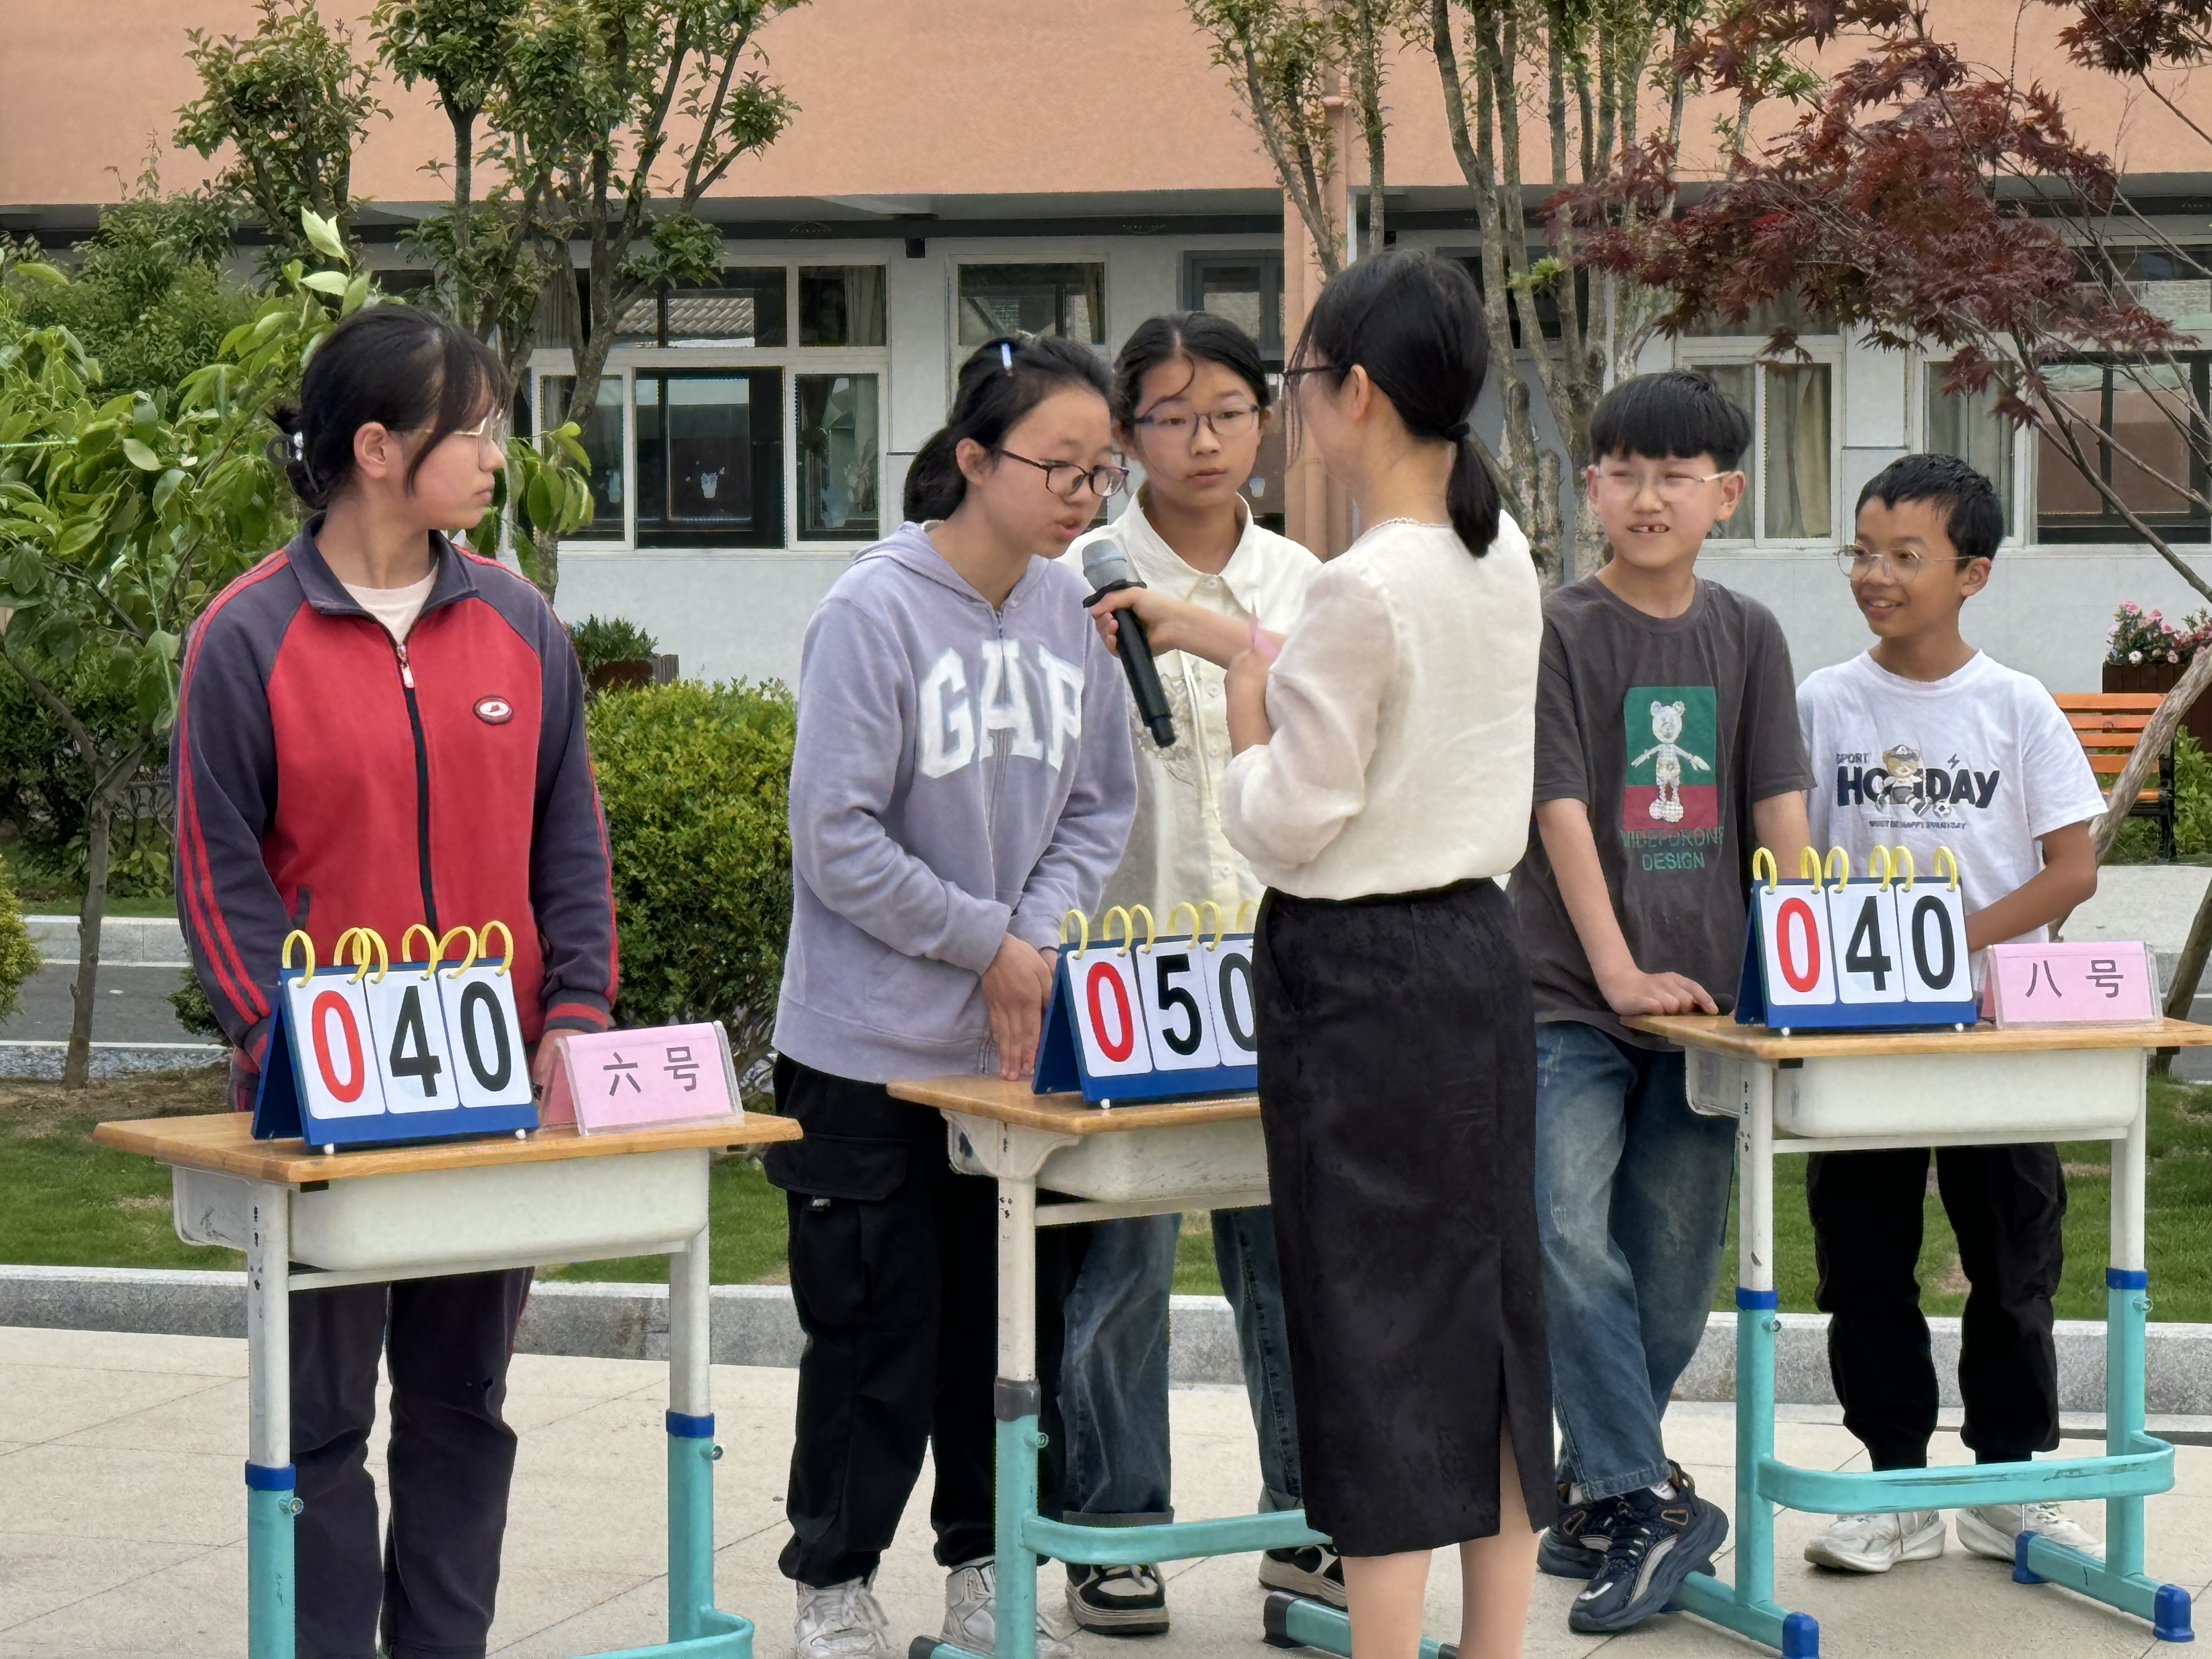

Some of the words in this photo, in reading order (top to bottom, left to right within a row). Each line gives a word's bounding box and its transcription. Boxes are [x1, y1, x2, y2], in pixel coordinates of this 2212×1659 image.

[919, 639, 1085, 778] GAP
[1641, 851, 1706, 871] DESIGN
[1776, 895, 1955, 992] 040
[2025, 960, 2124, 998] 八号
[312, 981, 511, 1103] 040
[1086, 952, 1258, 1062] 050
[603, 1046, 699, 1096] 六号
